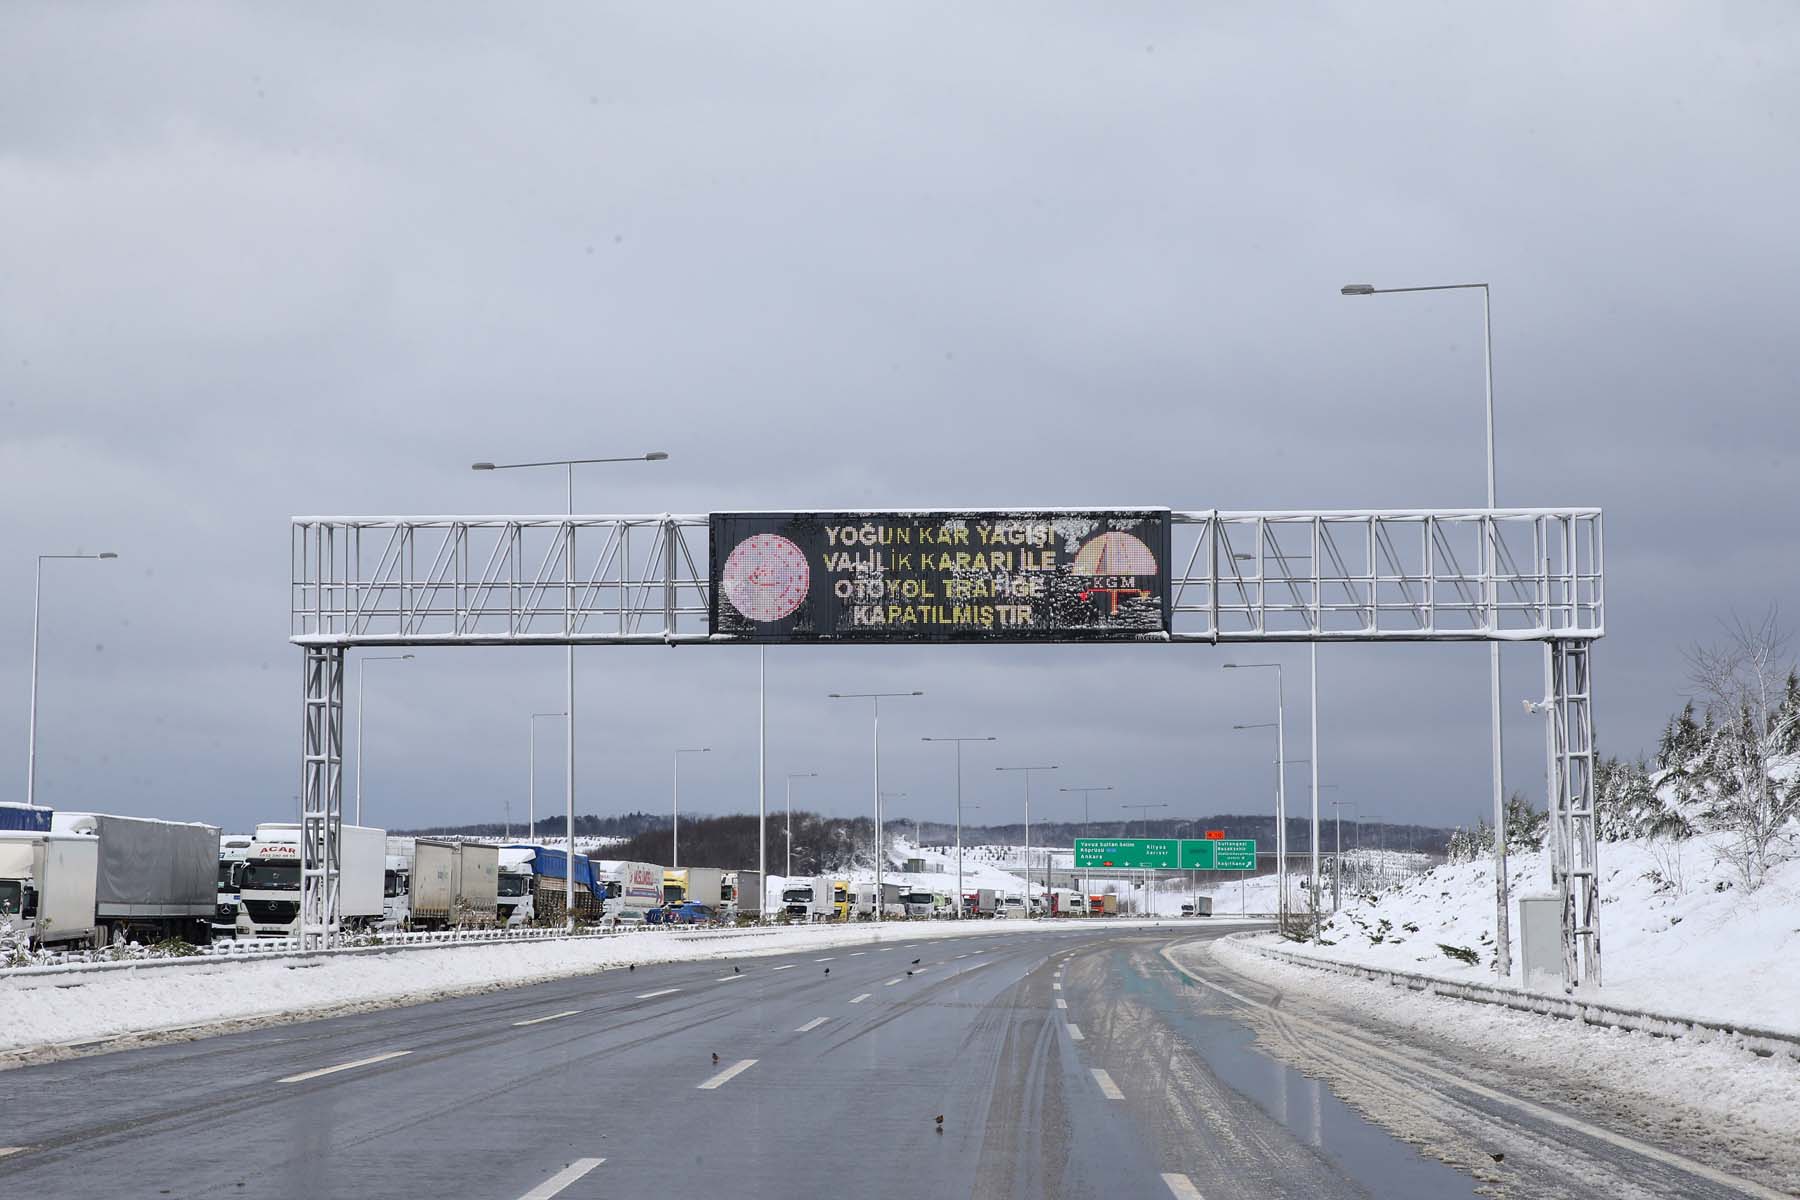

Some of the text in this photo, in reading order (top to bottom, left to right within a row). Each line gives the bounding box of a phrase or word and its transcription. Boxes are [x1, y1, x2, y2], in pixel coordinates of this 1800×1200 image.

[825, 522, 910, 546] YOĞUN
[919, 527, 969, 545] KAR
[823, 548, 1057, 572] VALİLİK KARARI İLE
[834, 579, 935, 598] OTOYOL
[1094, 576, 1136, 588] KGM
[853, 605, 1034, 629] KAPATILMIŞTIR
[259, 846, 296, 855] ACAR
